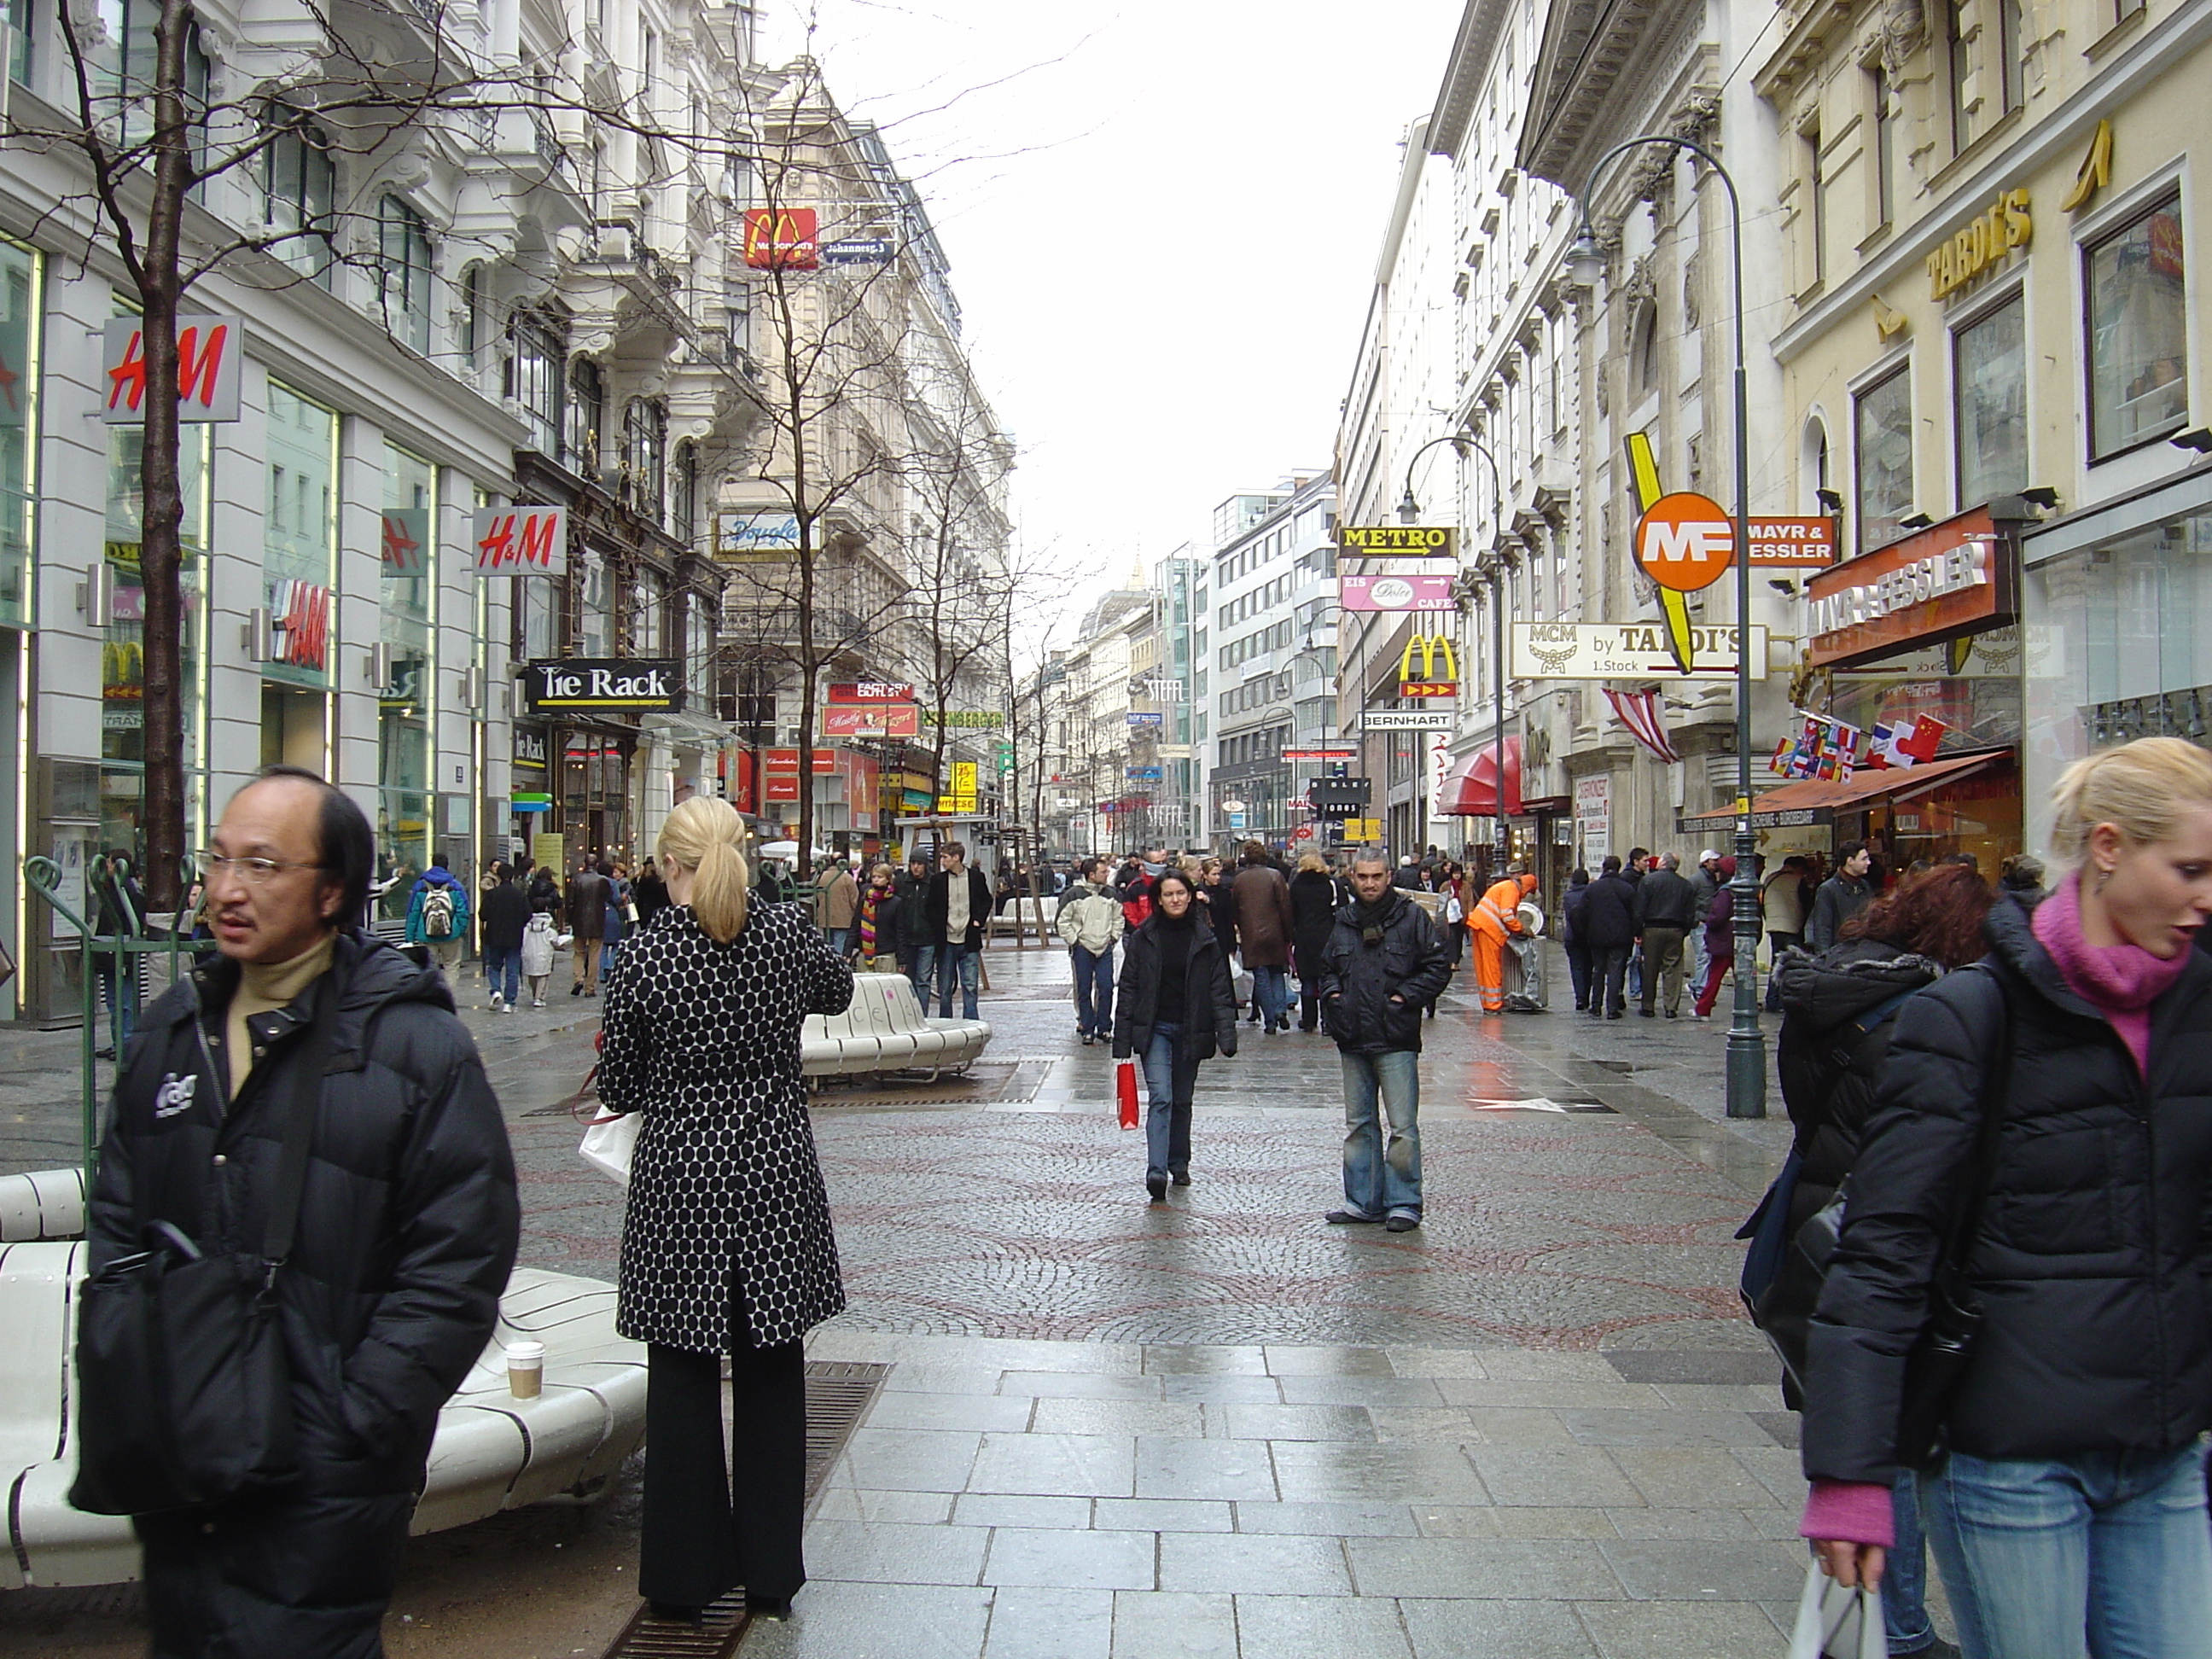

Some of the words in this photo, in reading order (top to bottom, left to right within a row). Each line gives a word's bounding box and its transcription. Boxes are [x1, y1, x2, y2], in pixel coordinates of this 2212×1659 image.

[756, 242, 813, 251] McDonad's
[1926, 188, 2031, 302] TARDI'S
[108, 324, 228, 411] HM
[478, 514, 558, 569] H&M
[731, 518, 800, 546] Dougla
[1344, 529, 1447, 547] METRO
[1642, 521, 1732, 562] MF
[1748, 525, 1805, 539] MAYR
[1809, 526, 1823, 538] &
[1749, 544, 1831, 559] ESSLER
[1344, 577, 1366, 588] EIS
[1877, 542, 1987, 615] FESSLER
[1528, 625, 1578, 642] MCM
[1592, 636, 1614, 655] by
[537, 667, 582, 699] Tie
[589, 668, 670, 697] Rack
[857, 683, 911, 691] FACTRY
[1145, 680, 1184, 702] STEFFL
[1364, 715, 1449, 725] BERNHART
[938, 799, 974, 808] HINESE
[1147, 805, 1184, 827] STEFFL
